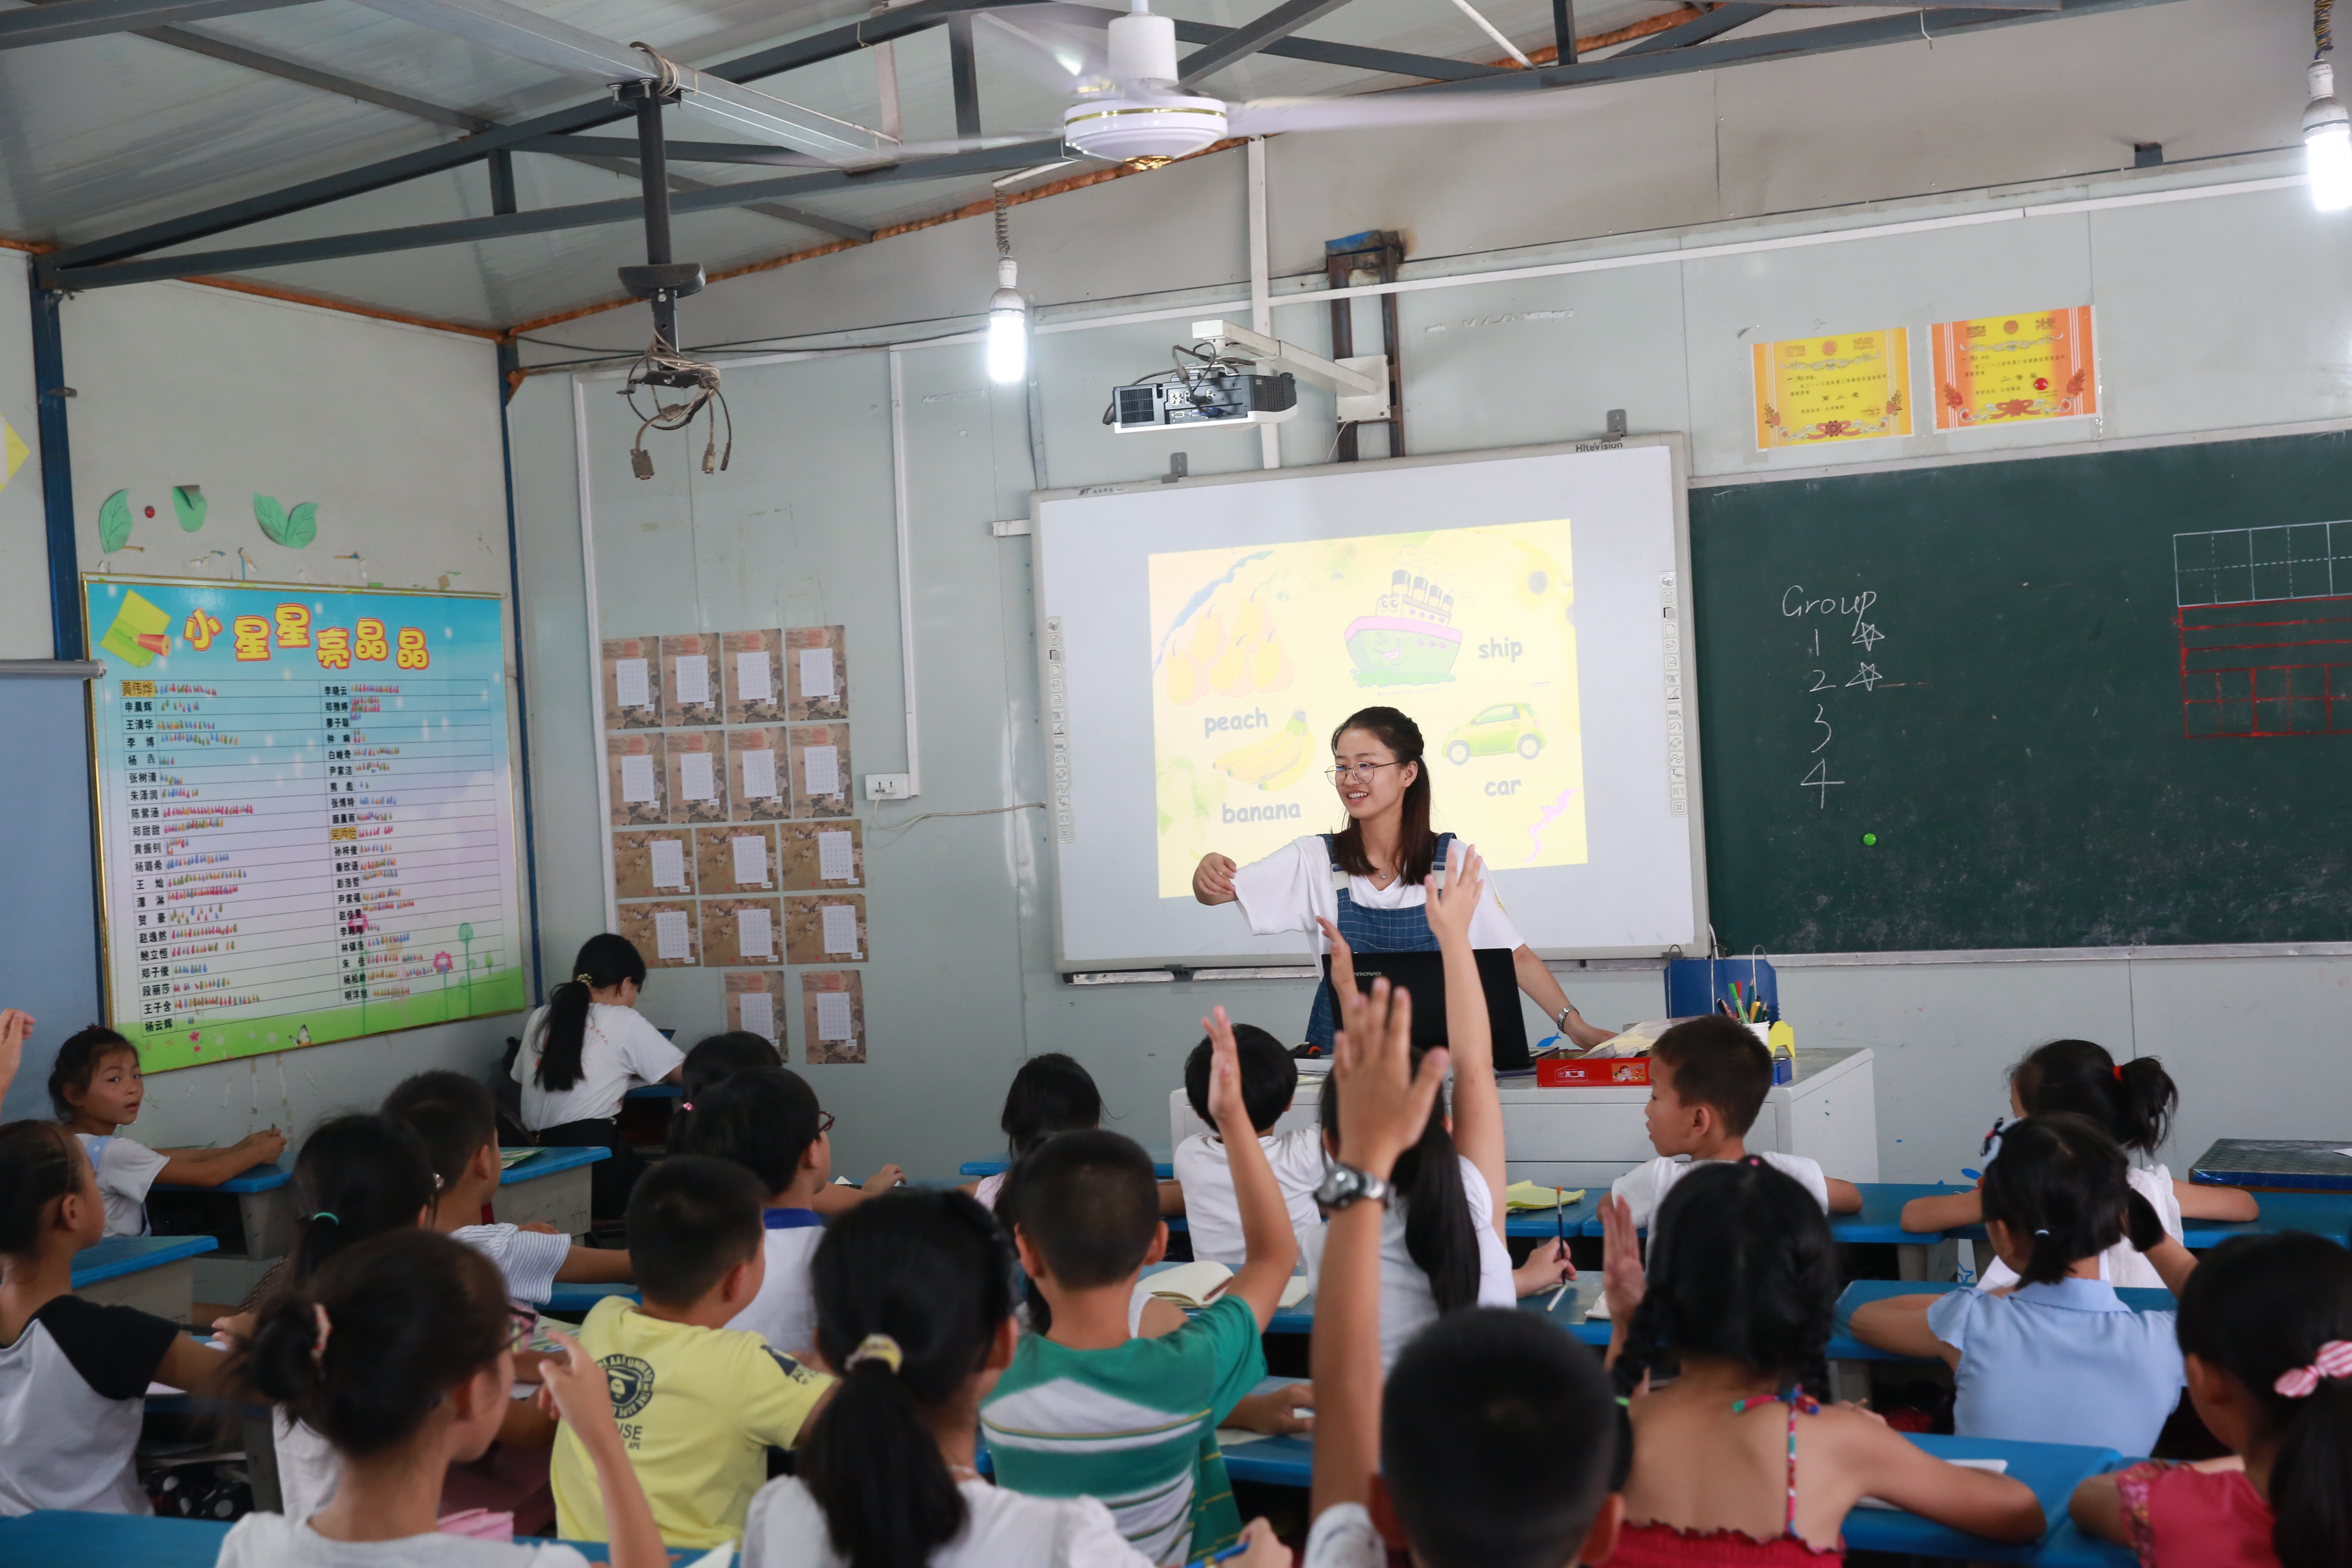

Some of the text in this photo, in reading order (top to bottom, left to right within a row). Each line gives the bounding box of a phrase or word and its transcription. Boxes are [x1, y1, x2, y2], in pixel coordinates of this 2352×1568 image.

[1782, 585, 1877, 637] Group
[183, 602, 429, 670] 小星星亮晶晶
[1814, 628, 1819, 657] 1
[1478, 637, 1523, 663] ship
[1810, 670, 1836, 692] 2
[126, 719, 153, 730] 王清华
[1204, 707, 1269, 739] peach
[1811, 704, 1831, 753] 3
[1485, 779, 1522, 797] car
[1800, 758, 1845, 809] 4
[1222, 802, 1301, 824] banana
[133, 825, 160, 836] 郑甜甜
